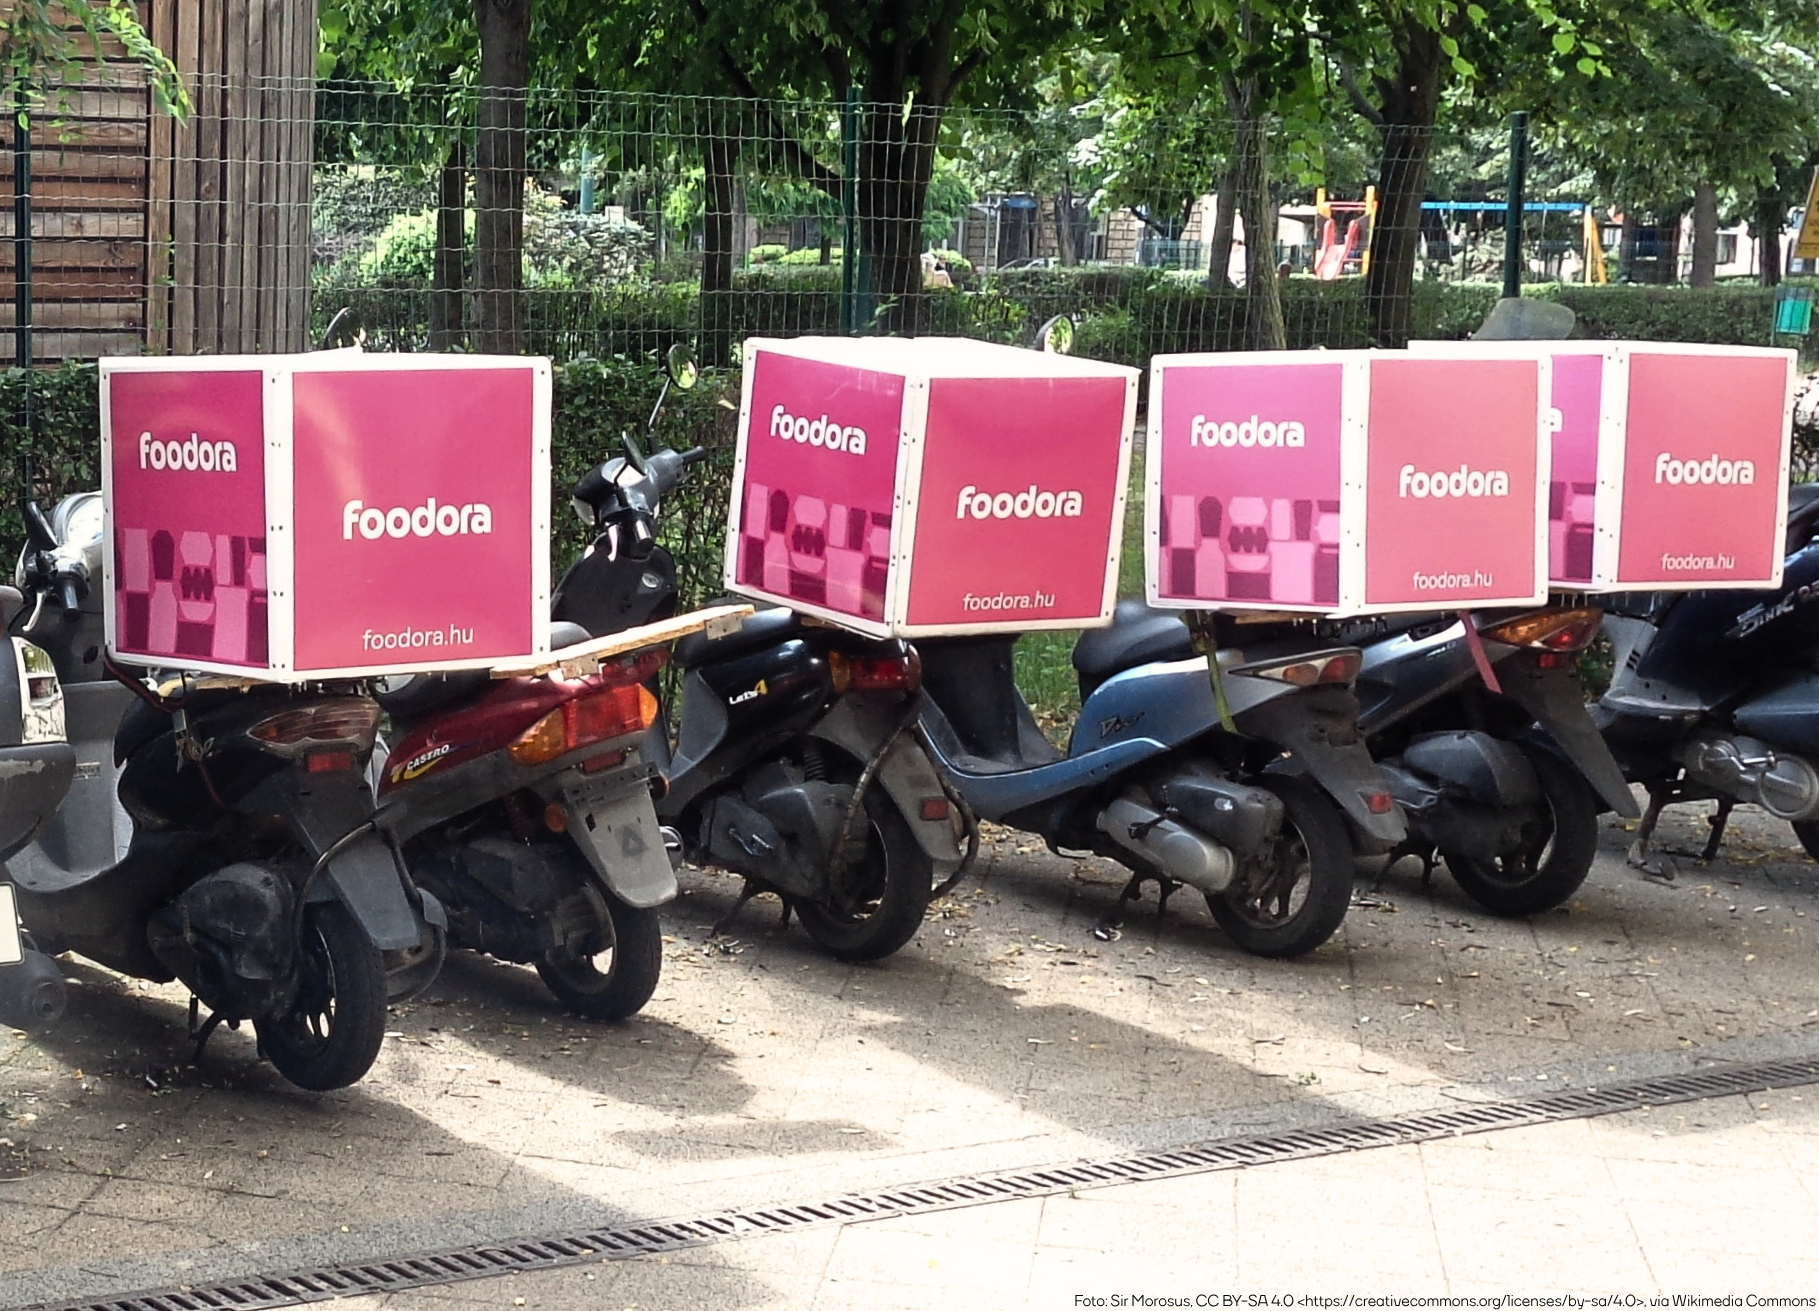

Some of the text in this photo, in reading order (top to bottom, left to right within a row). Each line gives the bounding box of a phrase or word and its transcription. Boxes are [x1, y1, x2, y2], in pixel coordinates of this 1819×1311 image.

[770, 405, 866, 455] foodora
[1191, 414, 1305, 448] foodora
[139, 431, 237, 473] foodora
[1655, 452, 1755, 486] foodora
[1399, 464, 1509, 498] foodora
[343, 497, 493, 541] foodora
[956, 485, 1083, 520] foodora
[1661, 552, 1735, 573] foodora.hu
[1412, 571, 1493, 590] foodora.hu
[963, 591, 1055, 611] foodora.hu
[362, 625, 474, 651] foodora.hu
[406, 744, 450, 771] CASTRO
